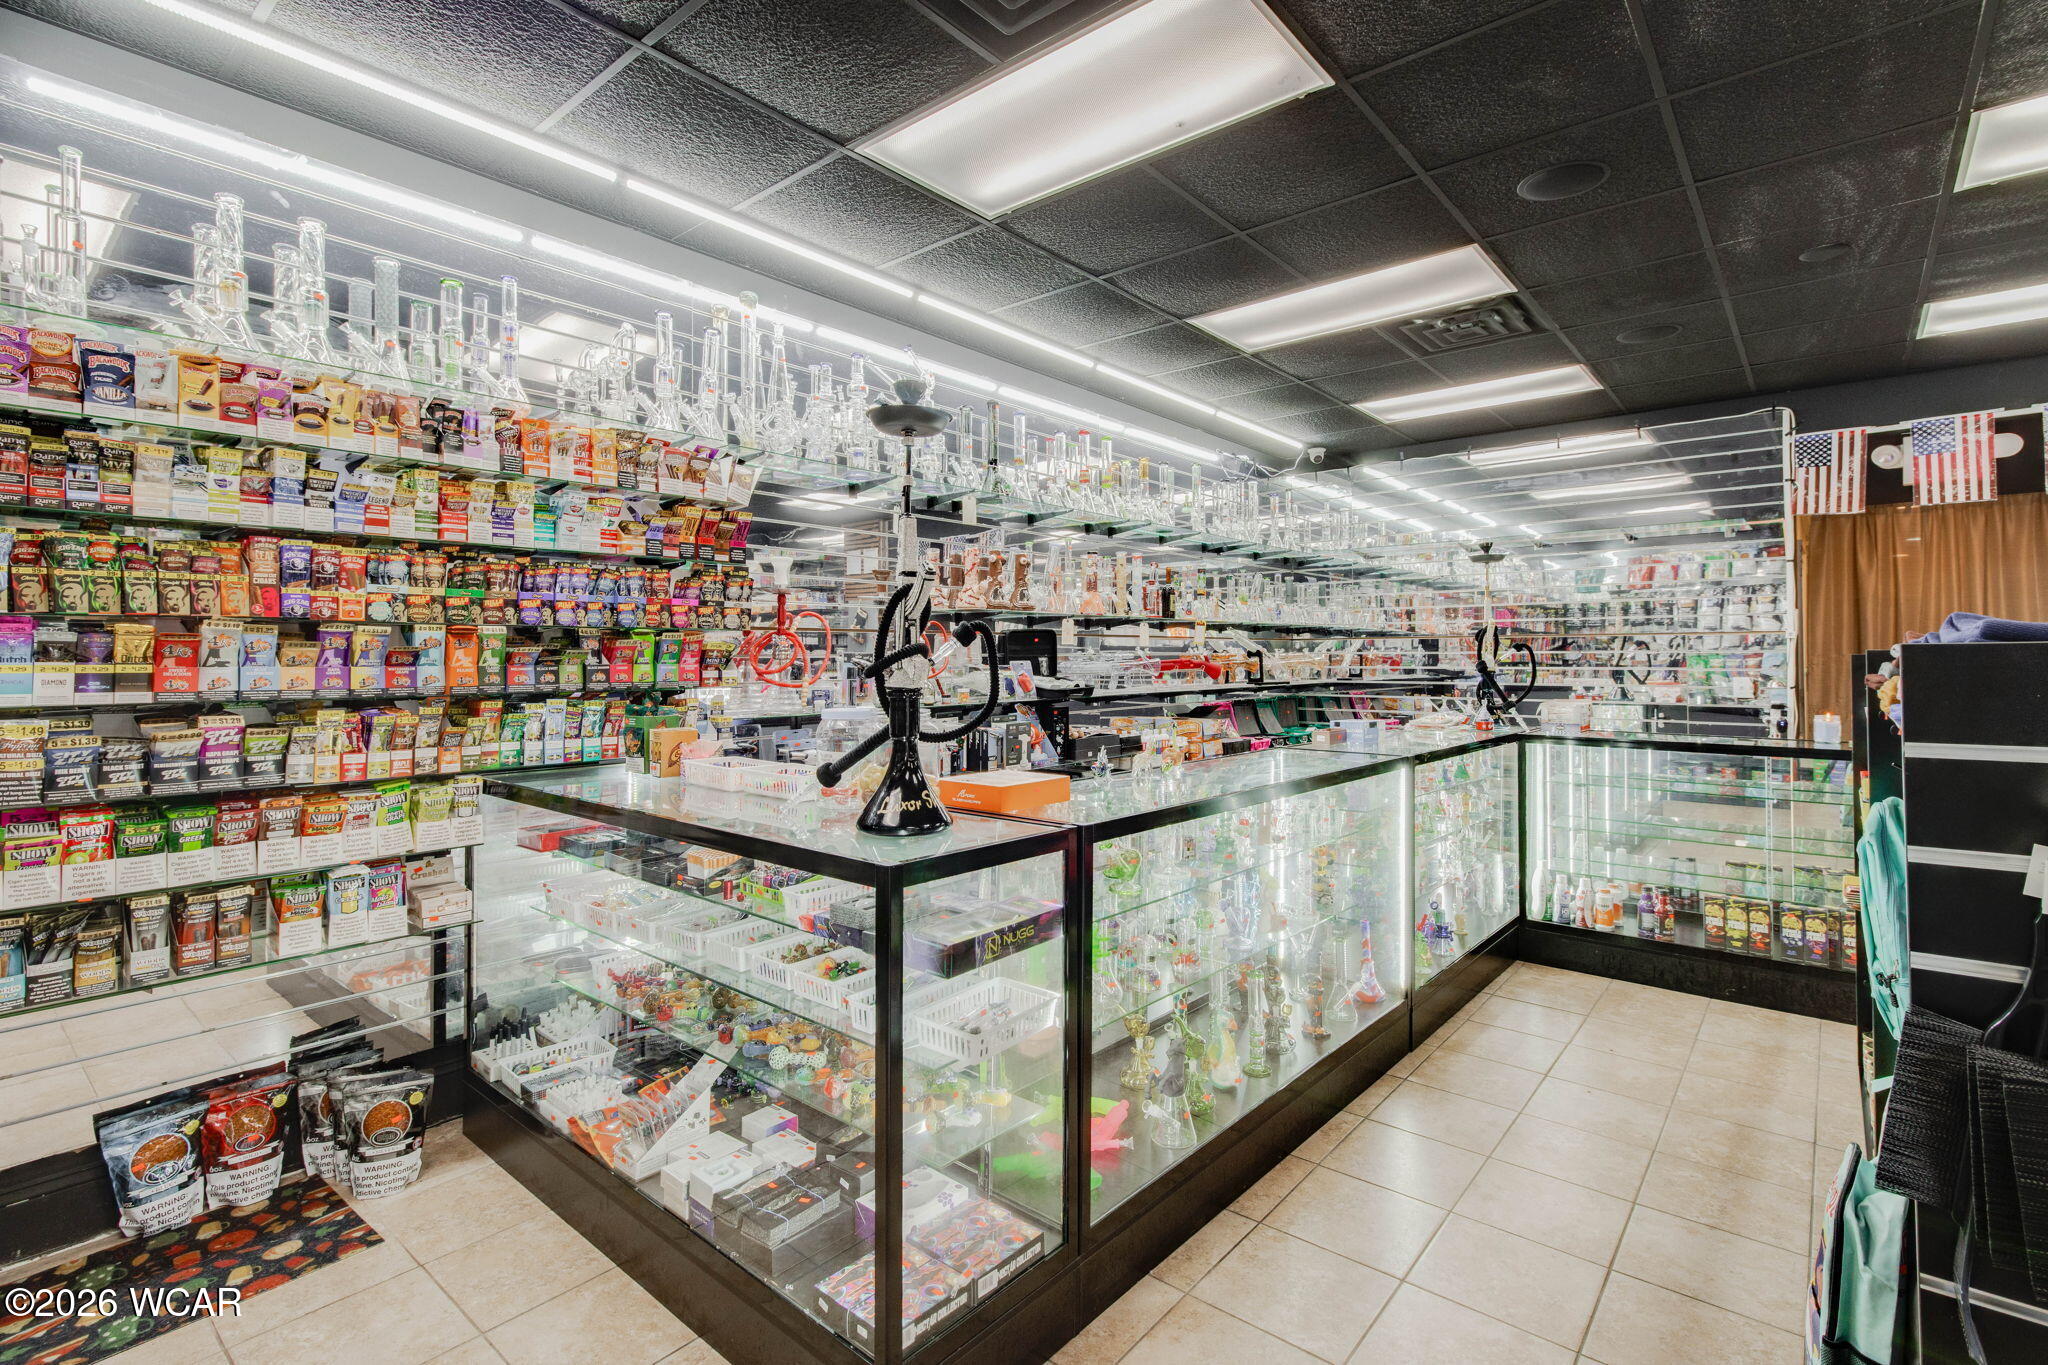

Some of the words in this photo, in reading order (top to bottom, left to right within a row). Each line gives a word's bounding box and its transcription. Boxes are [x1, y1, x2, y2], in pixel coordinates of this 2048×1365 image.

[88, 355, 130, 372] BACKWOODS
[33, 366, 77, 382] BACKWOODS
[94, 387, 127, 400] VANILLA
[33, 452, 65, 462] game
[103, 447, 131, 457] game
[35, 497, 59, 506] game
[72, 501, 95, 509] game
[105, 504, 128, 512] game
[64, 720, 90, 729] $1.39
[70, 737, 97, 746] $1.39
[103, 764, 122, 772] BLACK
[454, 786, 479, 795] SHOW
[380, 792, 407, 807] SHOW
[264, 809, 300, 821] SHOW
[310, 813, 343, 823] SHOW
[174, 816, 211, 832] SHOW
[219, 820, 255, 833] SHOW
[67, 824, 106, 839] SHOW
[122, 833, 161, 846] SHOW
[179, 834, 205, 843] GREEN
[11, 847, 55, 860] SHOW
[411, 867, 448, 880] Crushed
[369, 874, 398, 888] SHOW
[286, 891, 320, 905] SHOW
[230, 1164, 272, 1180] WARNING:
[364, 1161, 404, 1173] WARNING:
[362, 1171, 391, 1182] product
[375, 1176, 407, 1187] Nicotine
[226, 1178, 258, 1190] product
[242, 1179, 274, 1194] Nicotine
[141, 1193, 188, 1215] WARNING:
[139, 1209, 175, 1224] product
[1016, 1242, 1042, 1266] COLLECTOR
[937, 1292, 968, 1322] COLLECTOR
